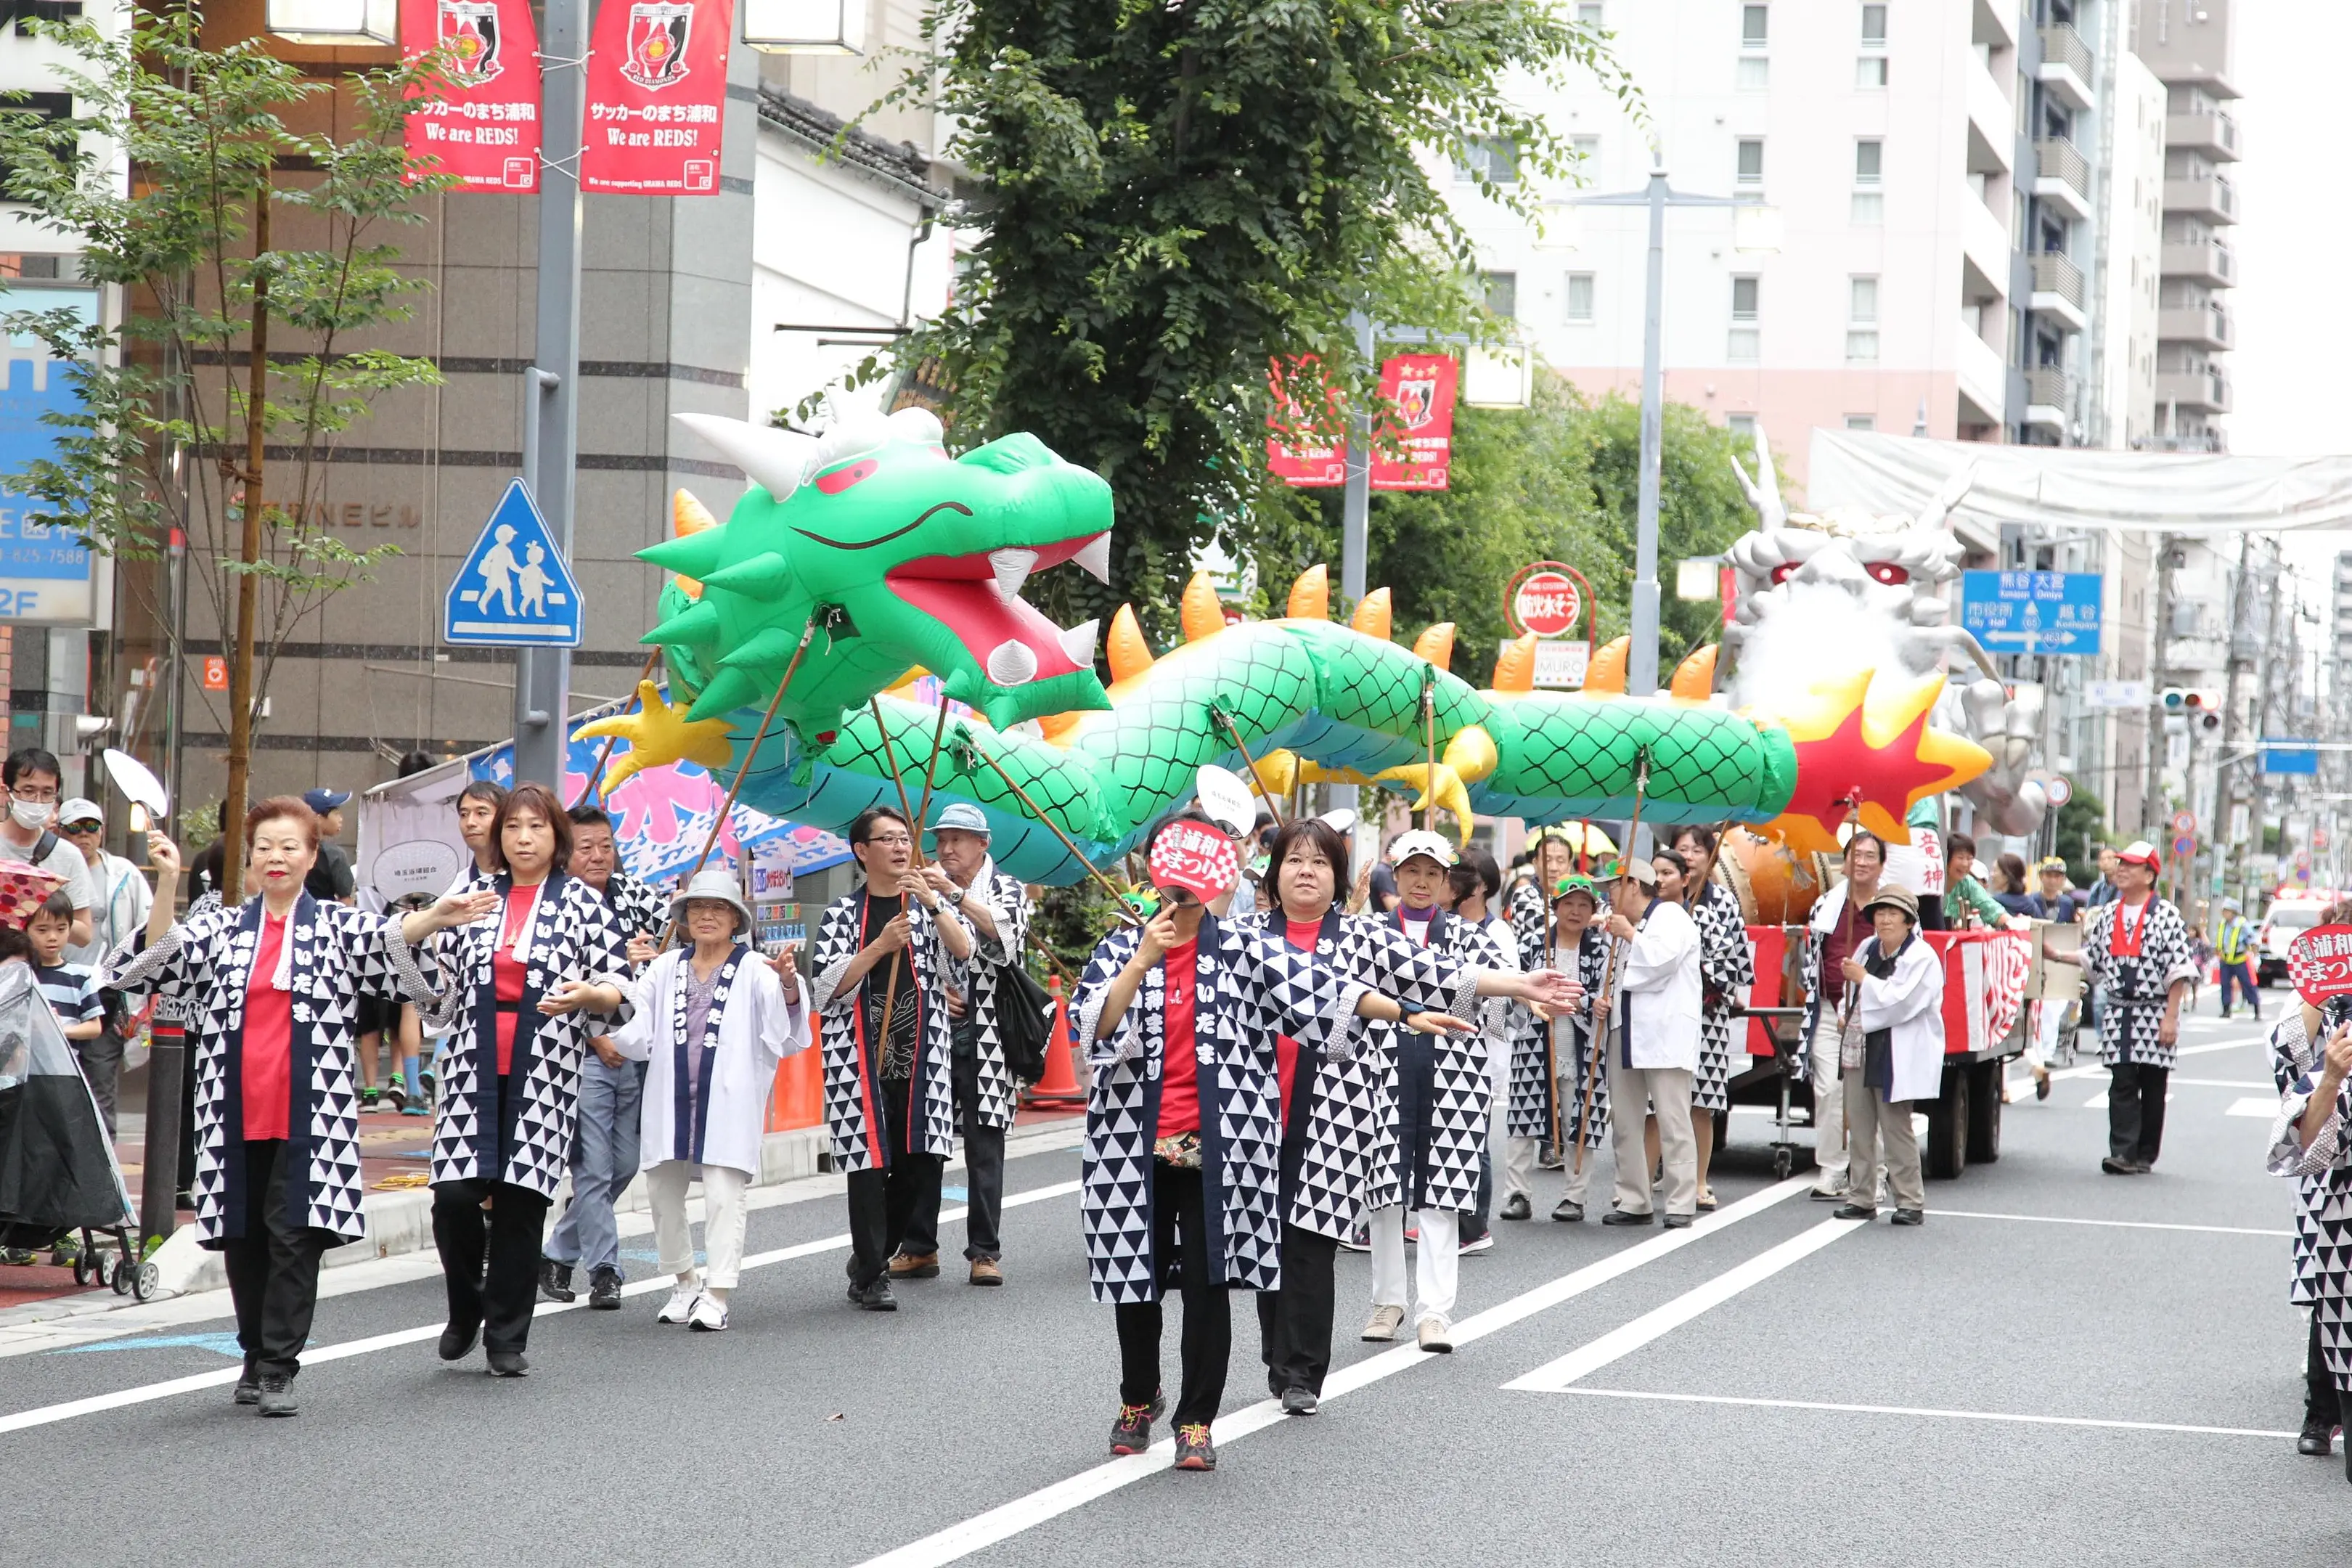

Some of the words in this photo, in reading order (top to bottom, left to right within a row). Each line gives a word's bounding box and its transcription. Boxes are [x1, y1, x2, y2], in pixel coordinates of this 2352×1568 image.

[410, 100, 536, 121] ッカーのまち浦和
[590, 102, 718, 123] サッカーのまち浦和
[425, 122, 446, 141] We
[449, 127, 472, 143] are
[475, 126, 519, 145] REDS!
[607, 127, 626, 146] We
[628, 134, 650, 147] are
[653, 128, 698, 147] REDS!
[588, 176, 599, 185] We
[611, 180, 642, 189] supporting
[666, 180, 683, 189] REDS
[2035, 573, 2065, 590] 大宮
[1520, 594, 1577, 618] 防火水そう
[1180, 828, 1220, 858] 浦和
[1167, 849, 1218, 881] まつり
[525, 899, 558, 989] さいたま
[292, 923, 314, 1024] さいたま
[2308, 955, 2352, 981] まつ
[703, 963, 737, 1048] さいたま
[1195, 953, 1216, 1066] さいたま
[1144, 966, 1165, 1082] 竜神まつり
